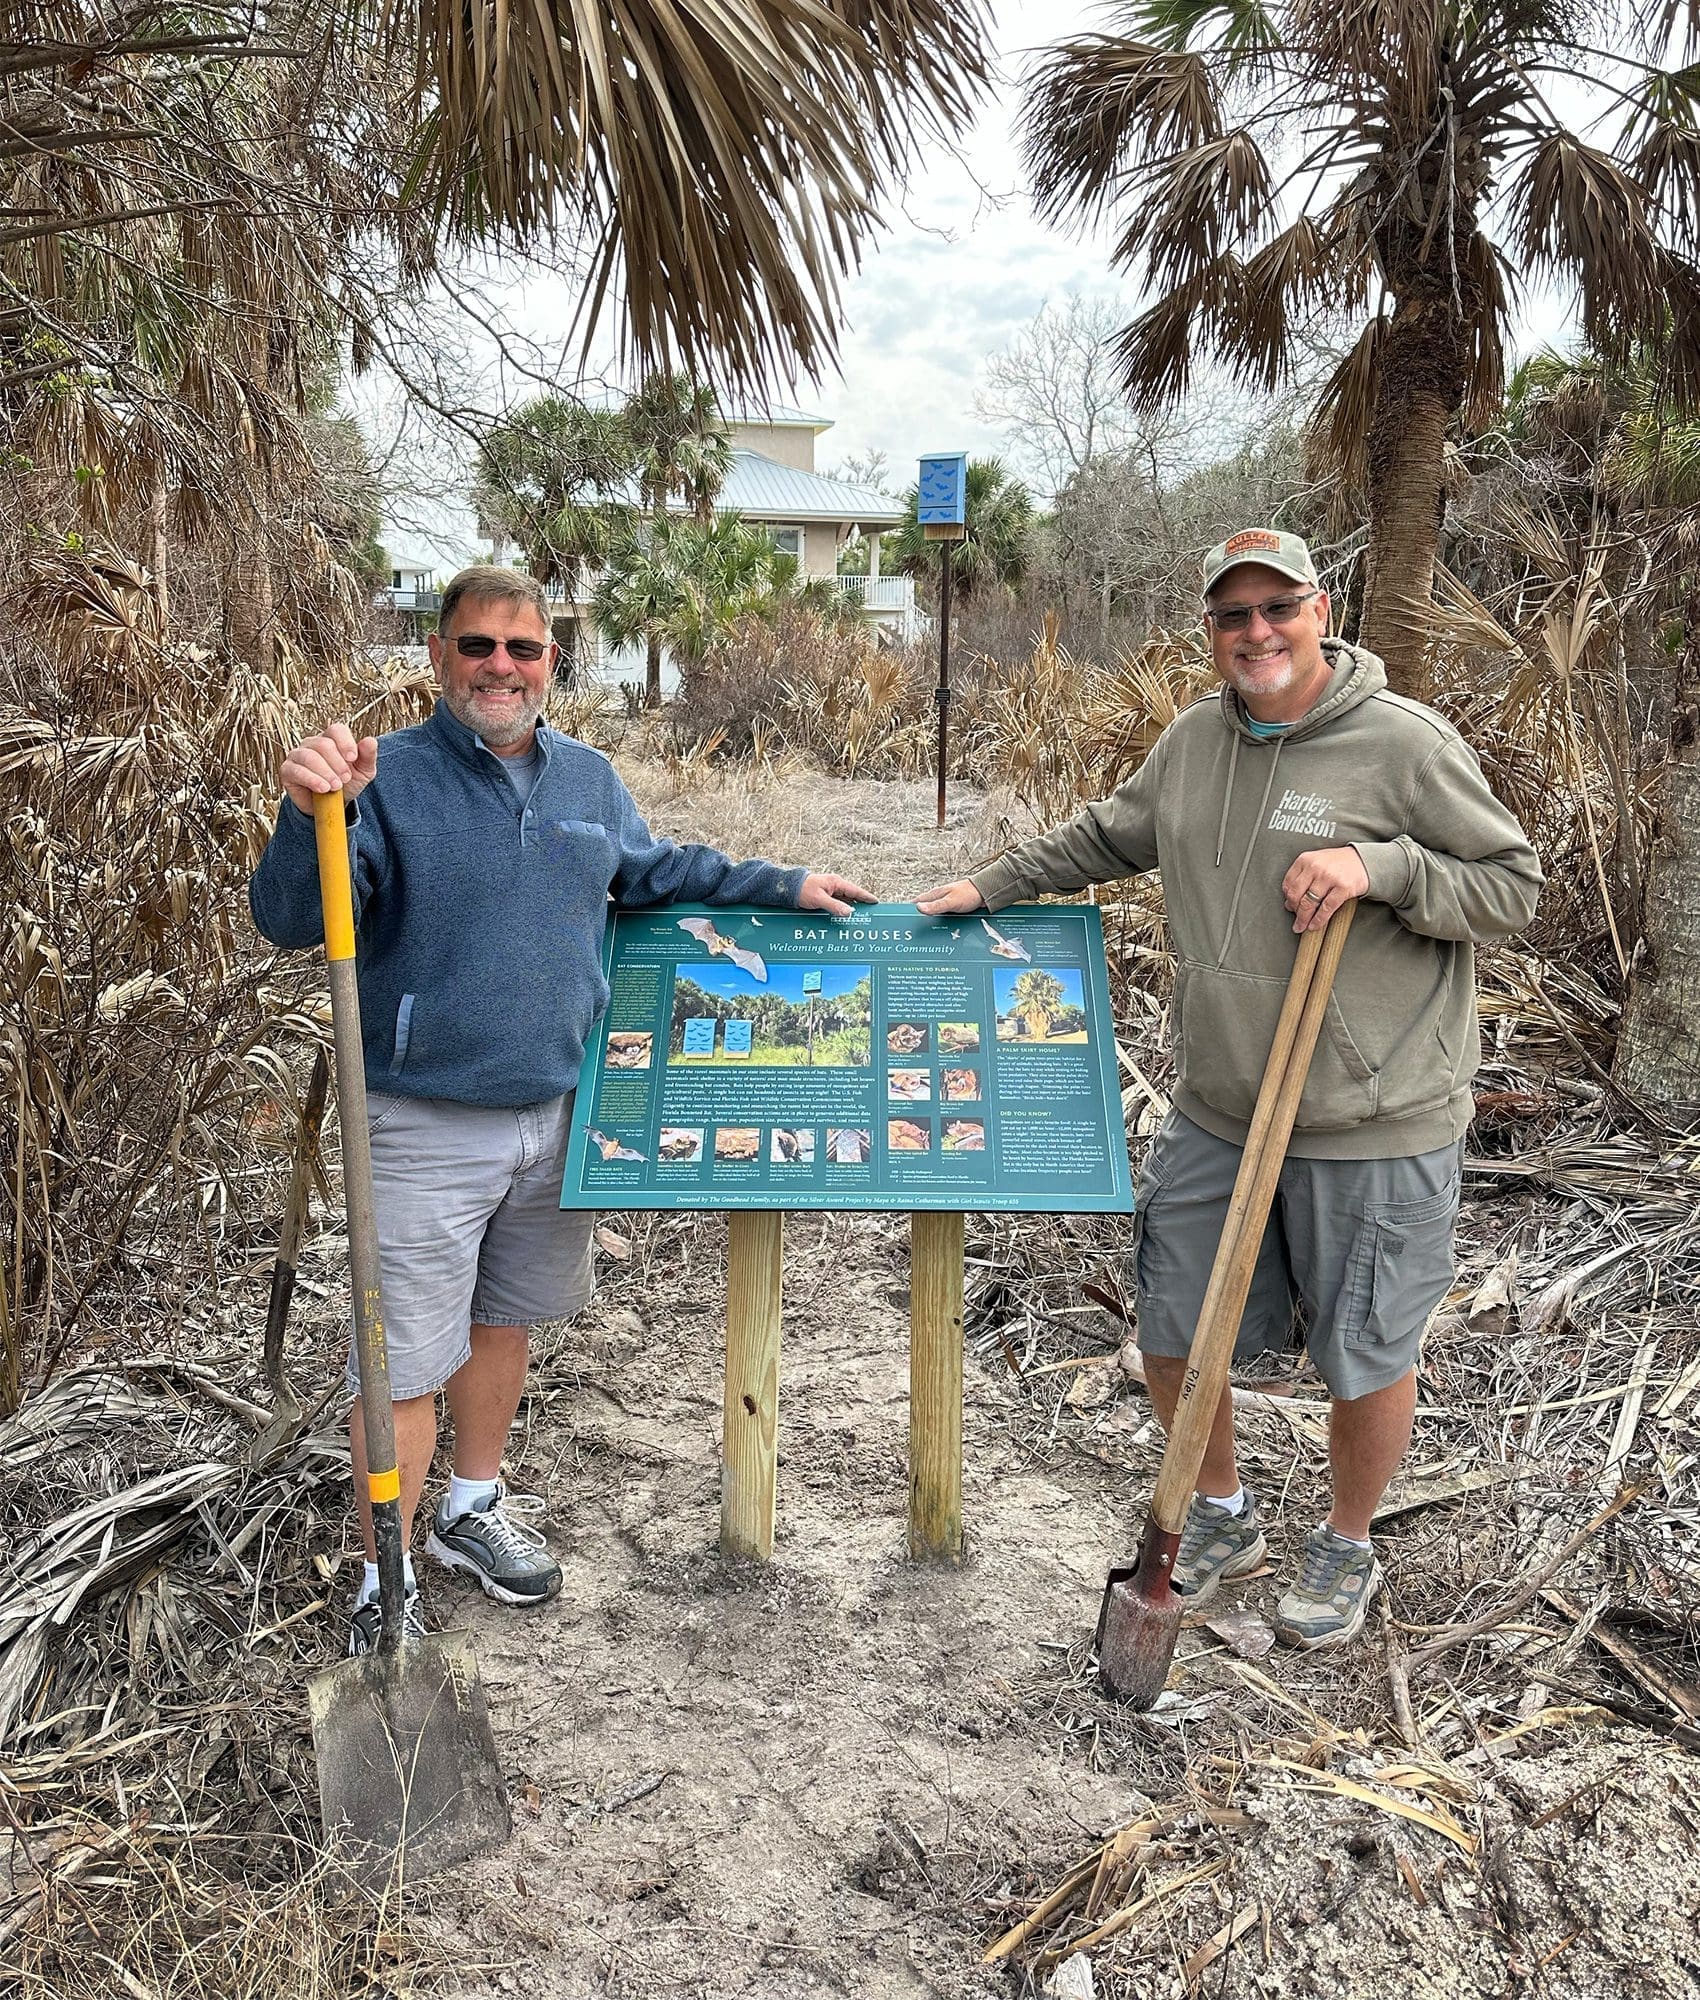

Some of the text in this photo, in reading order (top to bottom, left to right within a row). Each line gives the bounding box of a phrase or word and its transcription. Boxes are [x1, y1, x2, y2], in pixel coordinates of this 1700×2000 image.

[1278, 789, 1336, 817] Harley-
[1267, 809, 1337, 839] Davidson
[794, 929, 912, 940] BAT HOUSES
[769, 943, 955, 956] Welcoming Bats To Your Community
